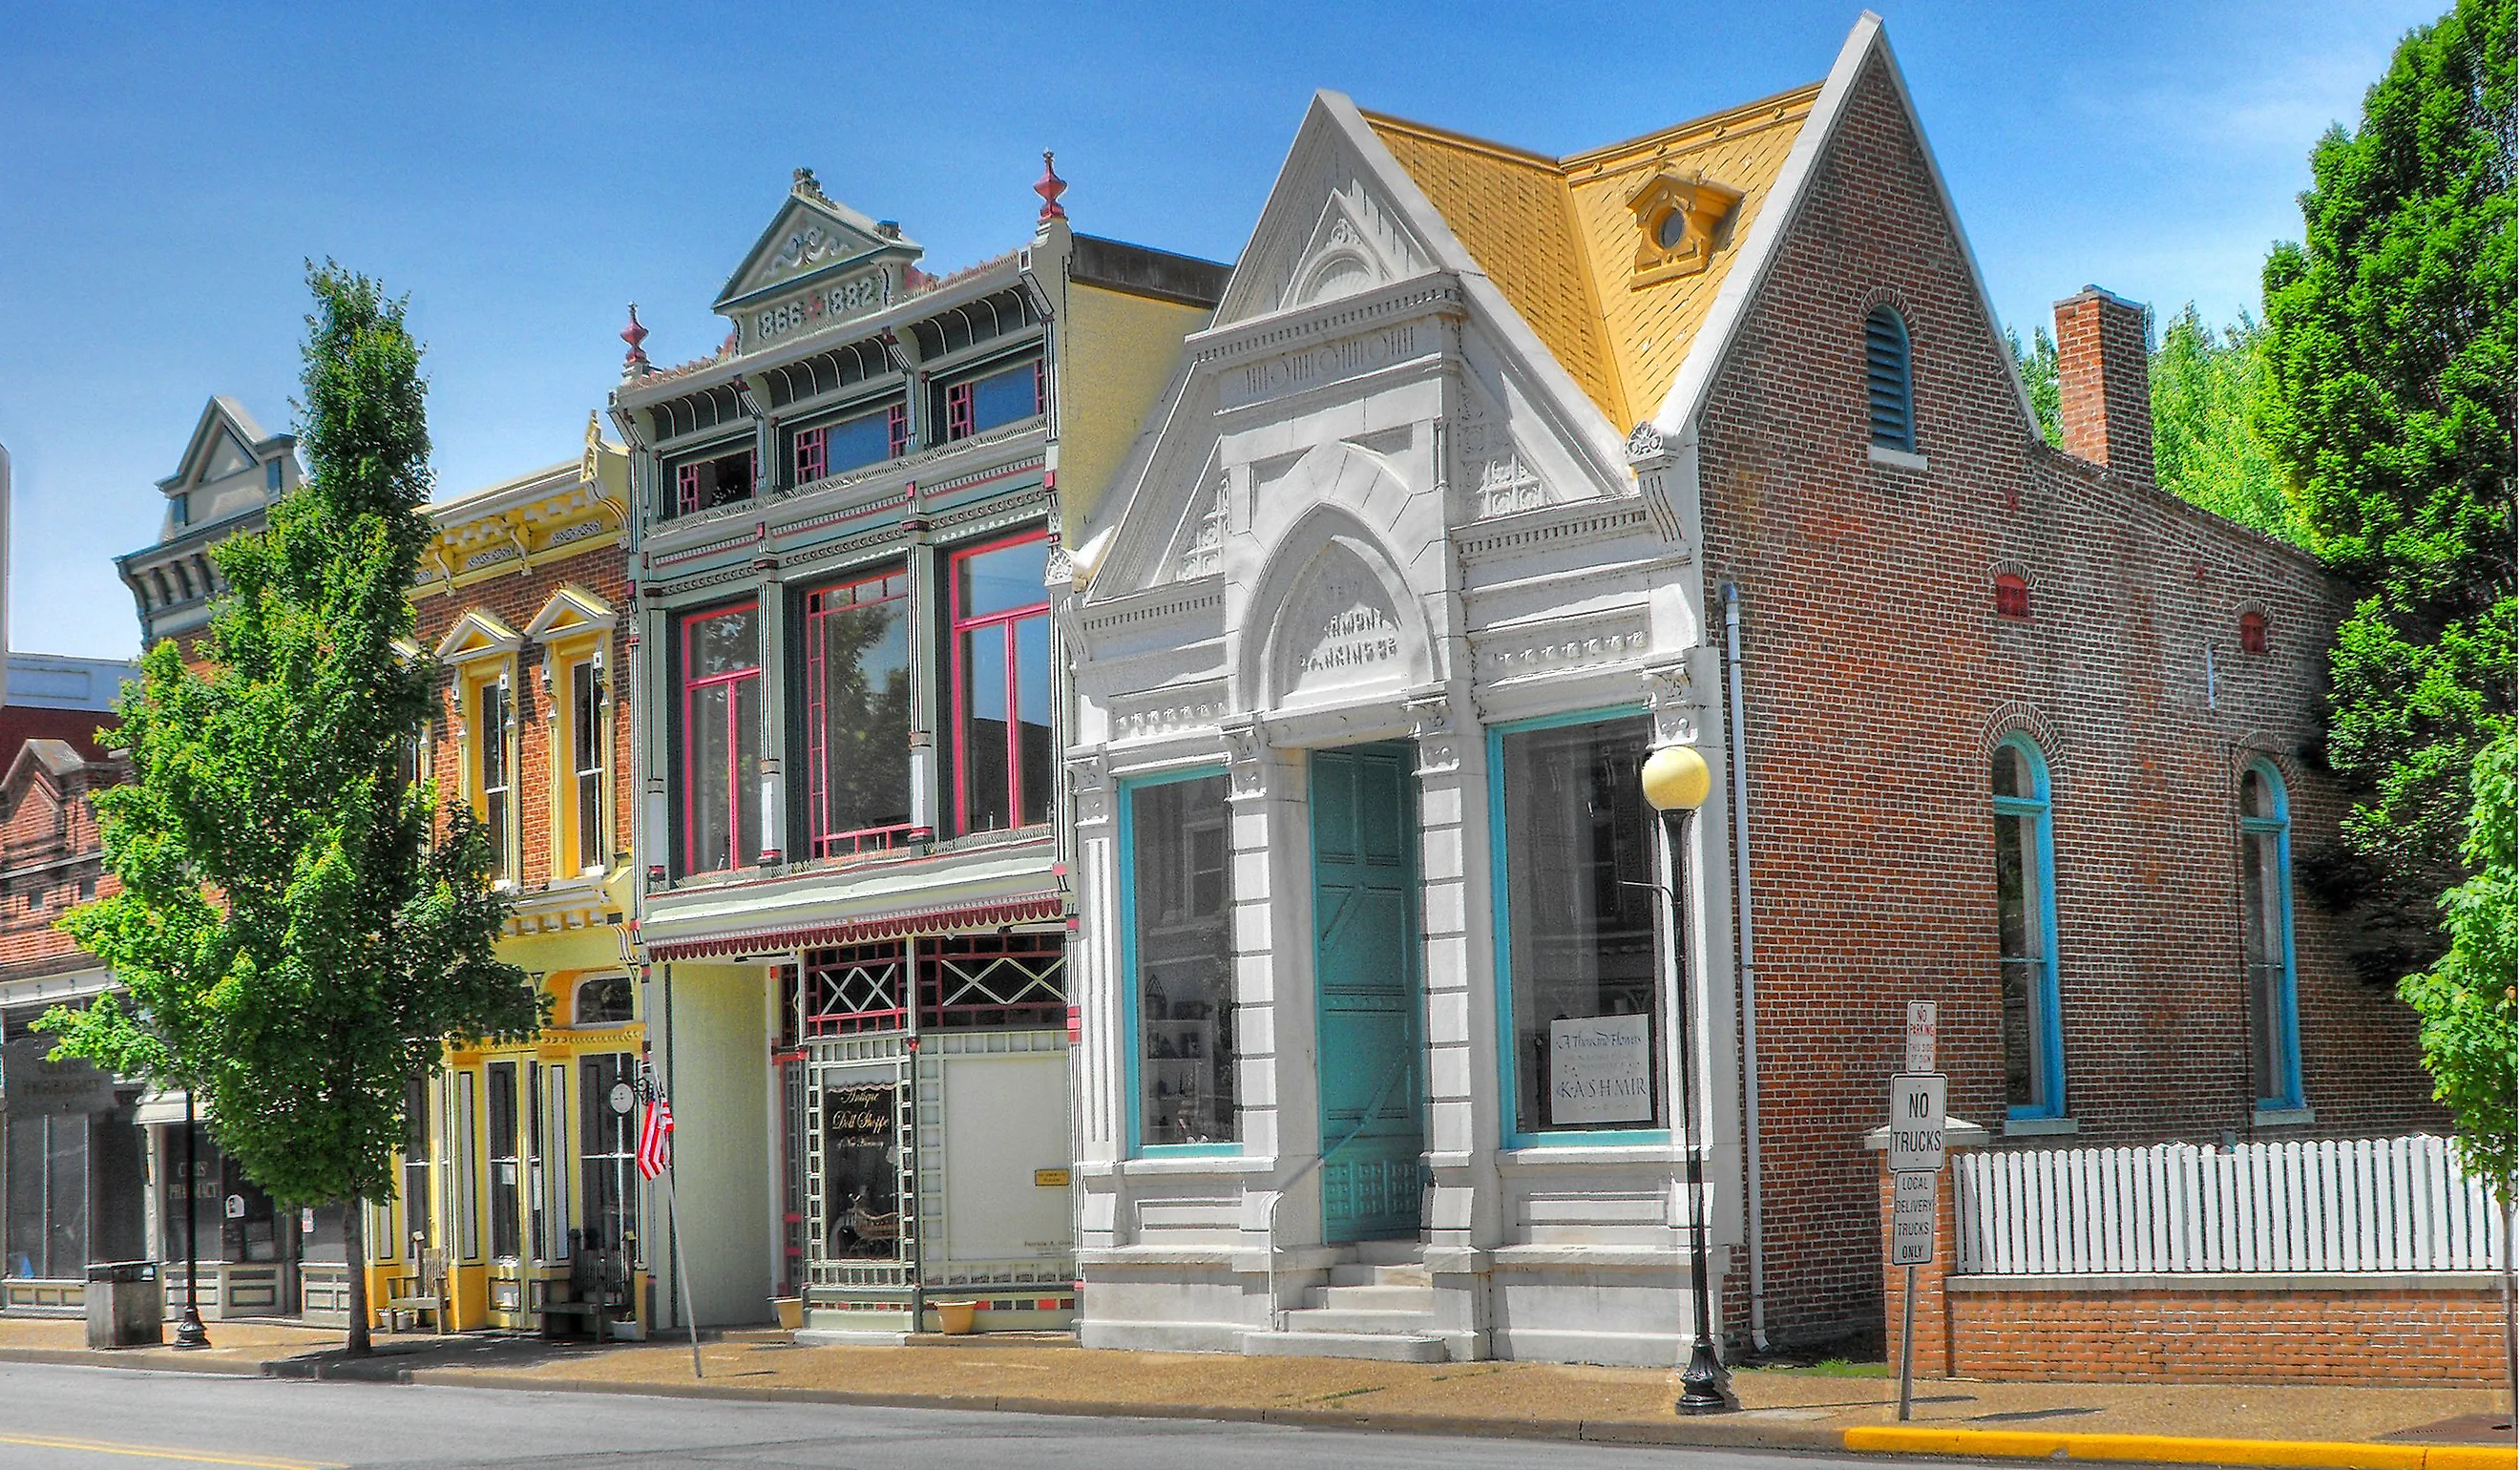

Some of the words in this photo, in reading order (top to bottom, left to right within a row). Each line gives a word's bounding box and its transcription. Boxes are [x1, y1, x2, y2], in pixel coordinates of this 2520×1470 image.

[825, 277, 873, 317] 1882
[1917, 1009, 1927, 1022] NO
[1560, 1078, 1647, 1098] KASHMIR
[1909, 1092, 1929, 1119] NO
[832, 1110, 857, 1129] Doll
[857, 1110, 890, 1134] Shoppe
[1893, 1130, 1942, 1152] TRUCKS
[1901, 1177, 1928, 1191] LOCAL
[1896, 1199, 1933, 1213] DELIVERY
[1898, 1222, 1929, 1236] TRUCKS
[1901, 1245, 1923, 1259] ONLY
